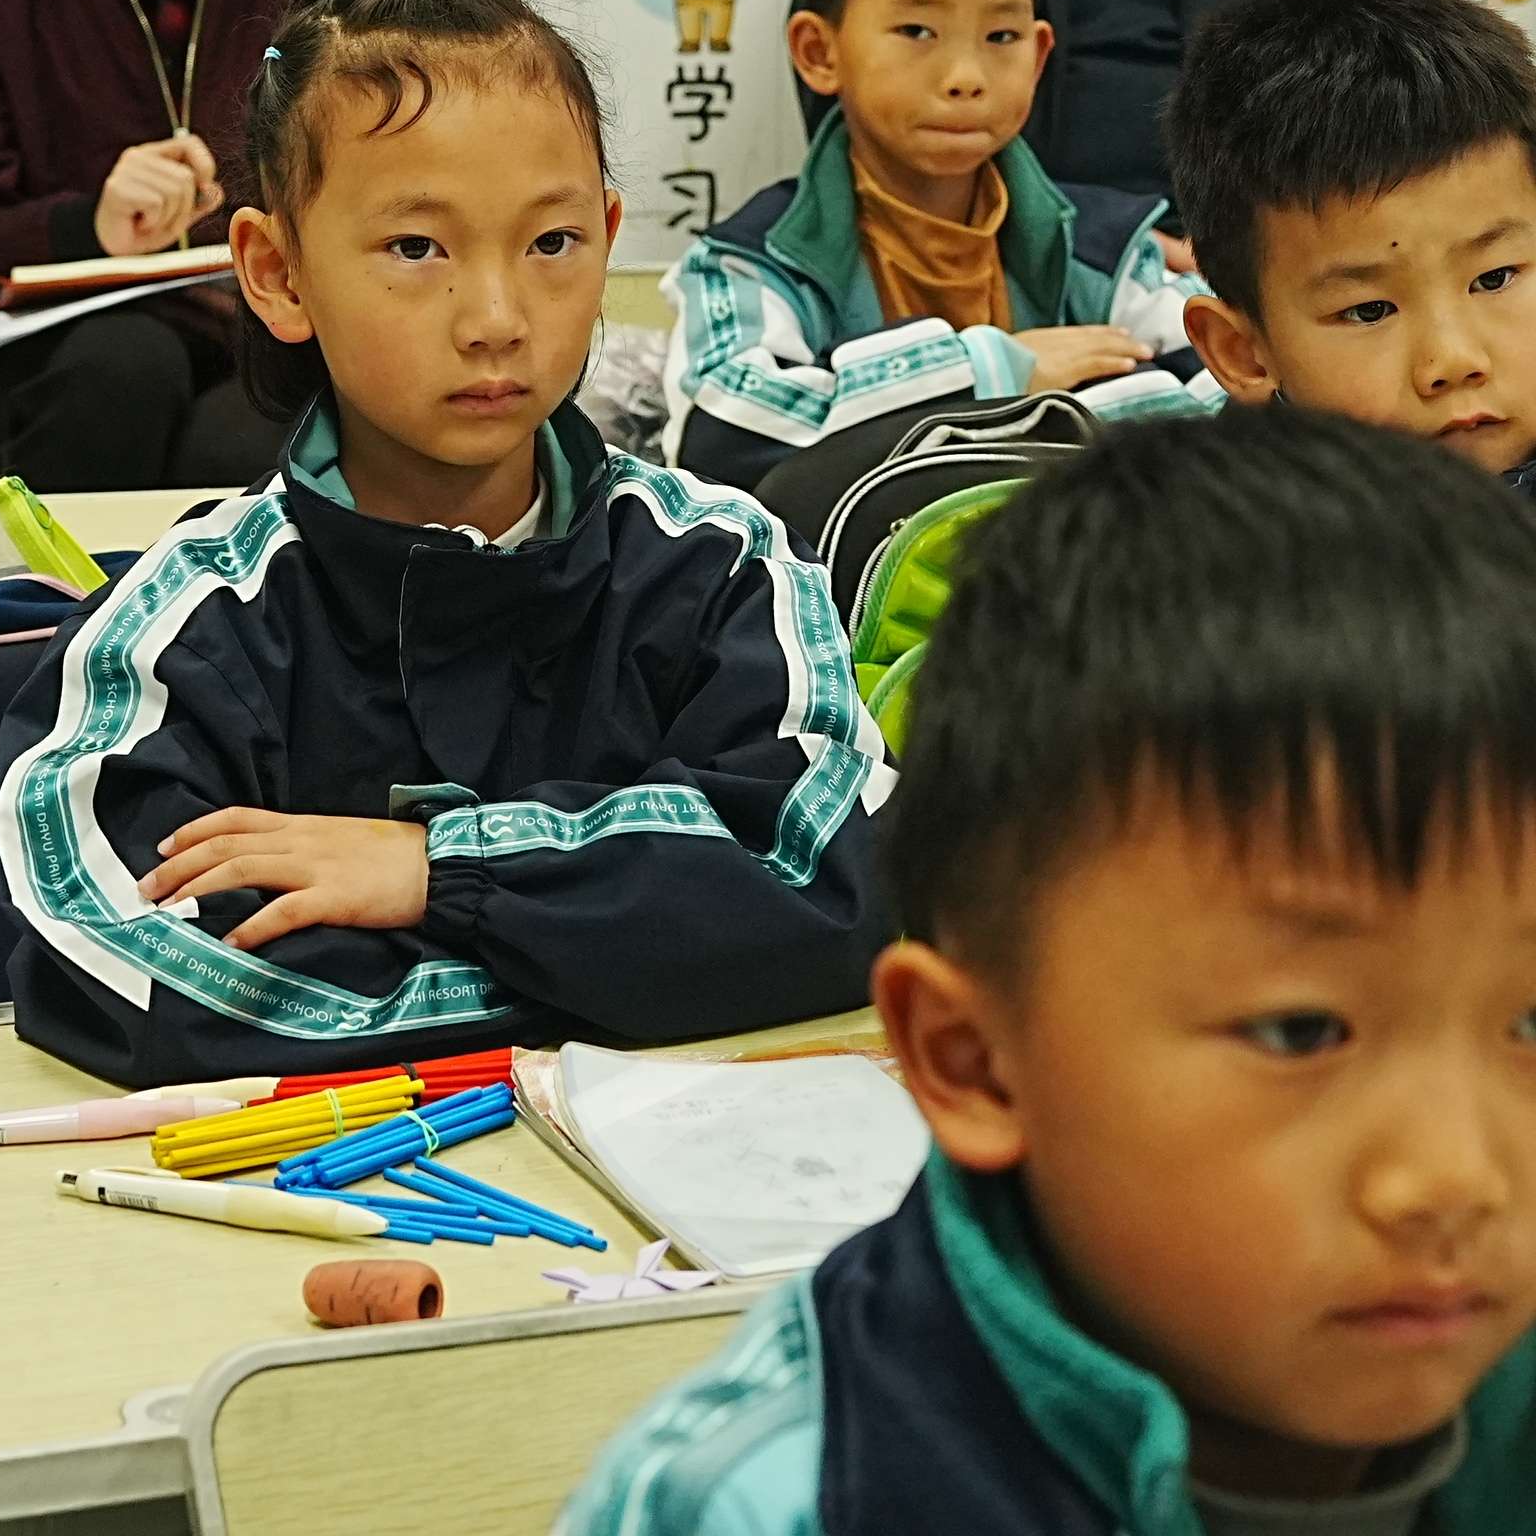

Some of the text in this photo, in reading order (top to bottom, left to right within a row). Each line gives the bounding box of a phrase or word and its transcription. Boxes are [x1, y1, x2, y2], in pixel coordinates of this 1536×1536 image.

[662, 66, 734, 236] 学习
[97, 682, 118, 739] SCHOOL
[34, 813, 55, 852] DAYU
[514, 816, 576, 837] SCHOOL
[133, 927, 186, 963] RESORT
[186, 956, 227, 985] DAYU
[226, 977, 281, 1007] PRIMARY
[279, 997, 336, 1025] SCHOOL
[427, 983, 478, 1002] RESORT
